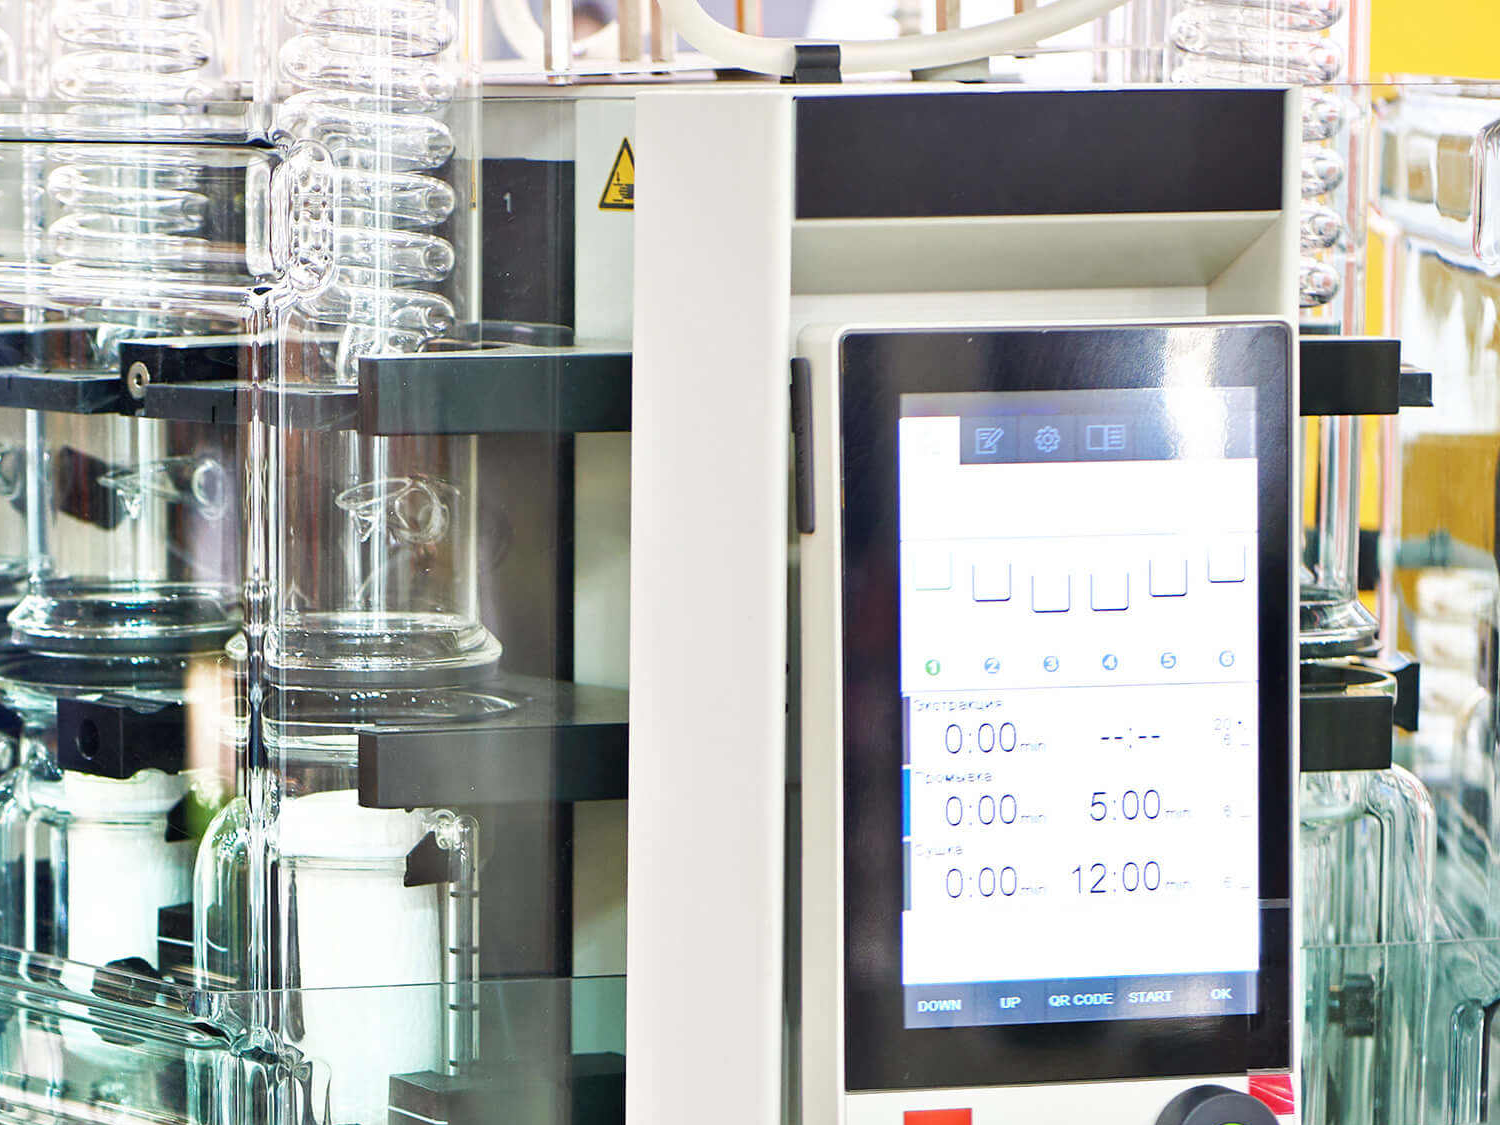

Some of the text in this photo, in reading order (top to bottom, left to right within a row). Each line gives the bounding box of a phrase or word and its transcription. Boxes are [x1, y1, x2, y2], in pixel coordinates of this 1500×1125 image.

[945, 722, 1017, 754] 0:00
[946, 794, 1017, 826] 0:00
[1090, 789, 1161, 821] 5:00
[946, 866, 1017, 898] 0:00
[1072, 860, 1161, 893] 12:00
[1049, 992, 1114, 1007] QR CODE
[1127, 990, 1175, 1004] START
[1211, 988, 1233, 1000] OK
[917, 999, 963, 1012] DOWN
[999, 996, 1022, 1009] UP
